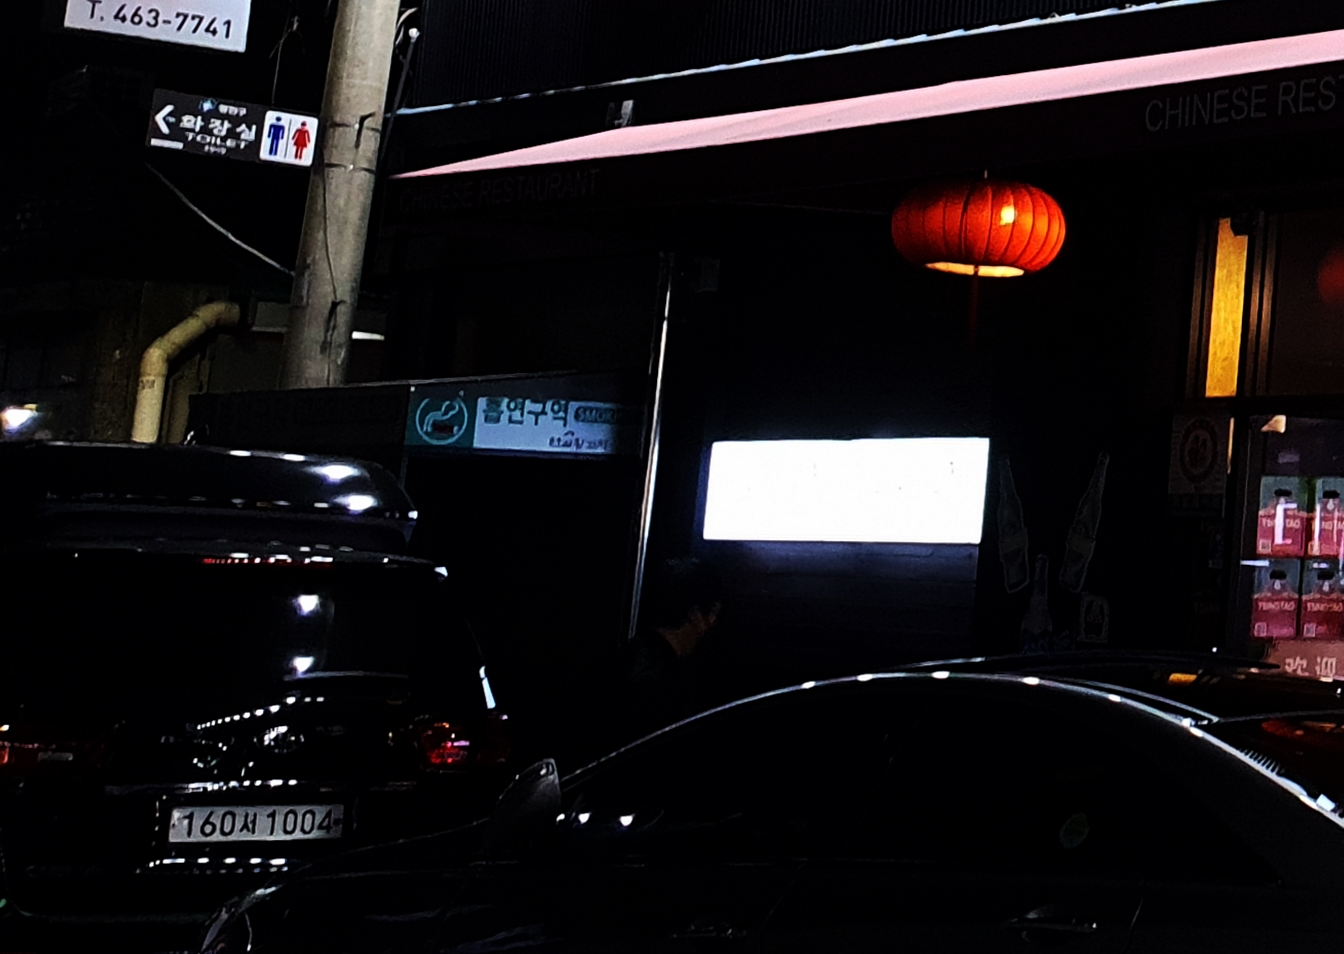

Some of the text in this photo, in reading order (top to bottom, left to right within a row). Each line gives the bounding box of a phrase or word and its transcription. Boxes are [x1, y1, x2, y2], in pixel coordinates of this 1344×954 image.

[113, 2, 235, 40] 463-7741
[1144, 84, 1268, 133] CHINESE
[179, 115, 257, 141] 화장실
[185, 132, 248, 149] TOILET
[483, 398, 569, 427] 흡연구역
[182, 808, 334, 837] 160서 1004
